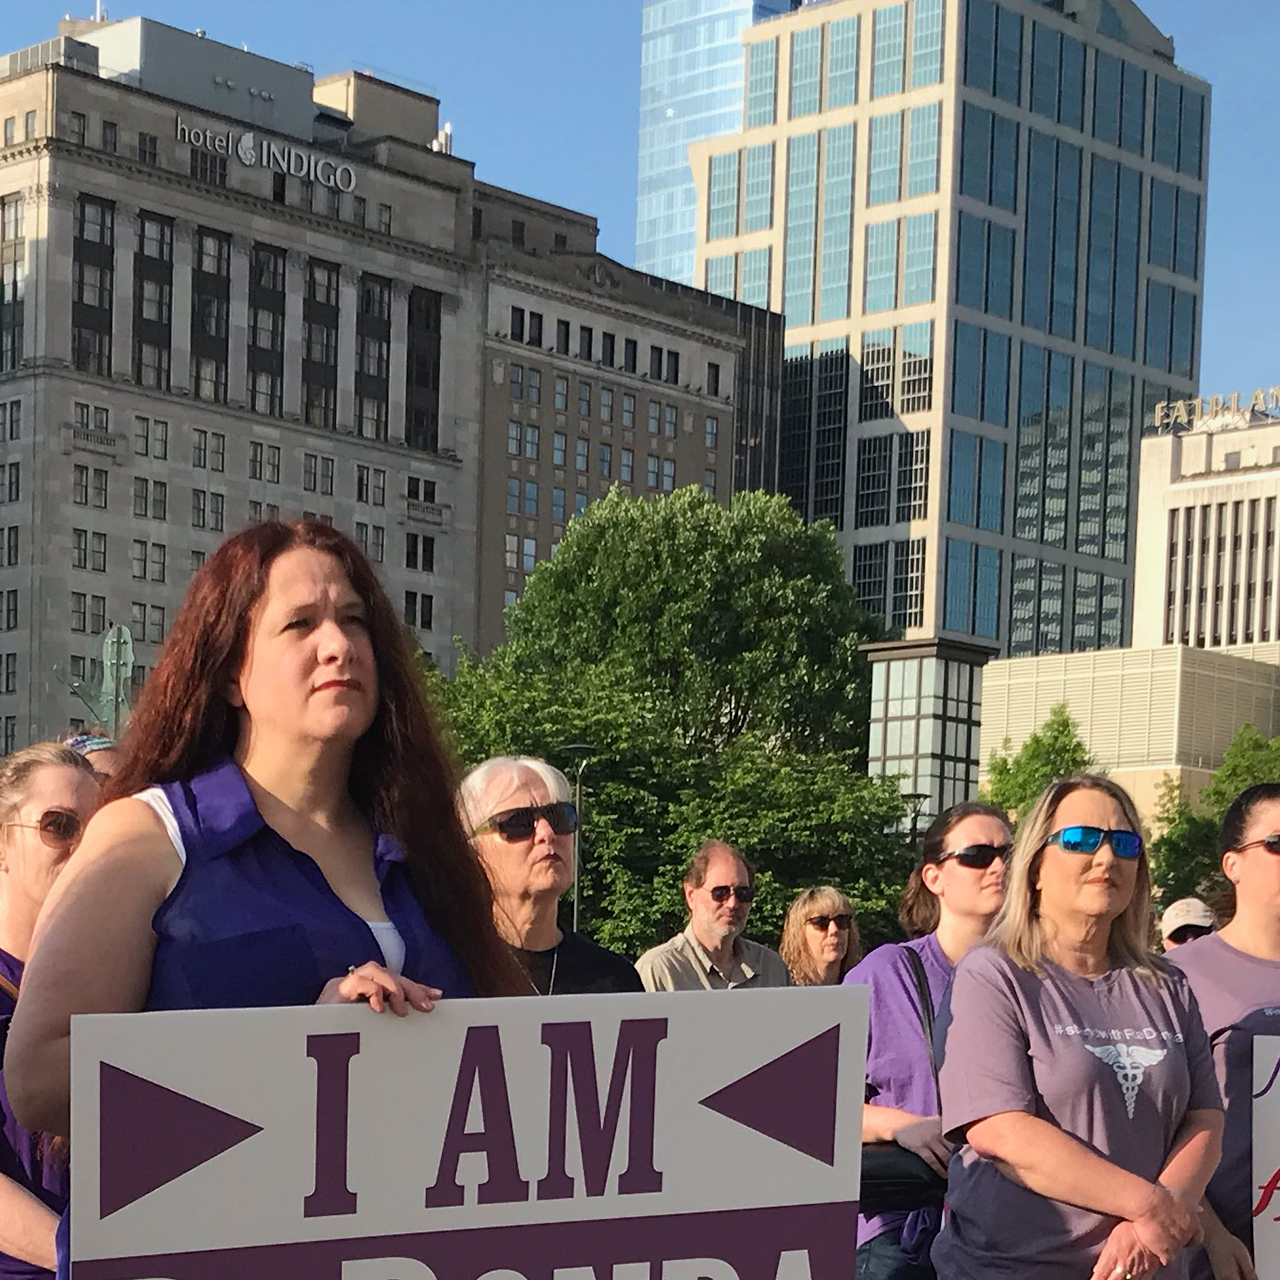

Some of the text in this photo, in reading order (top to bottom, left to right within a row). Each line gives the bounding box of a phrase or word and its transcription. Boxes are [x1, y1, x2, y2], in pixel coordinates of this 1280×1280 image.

[176, 113, 357, 193] hotel INDIGO
[303, 1017, 669, 1219] I AM
